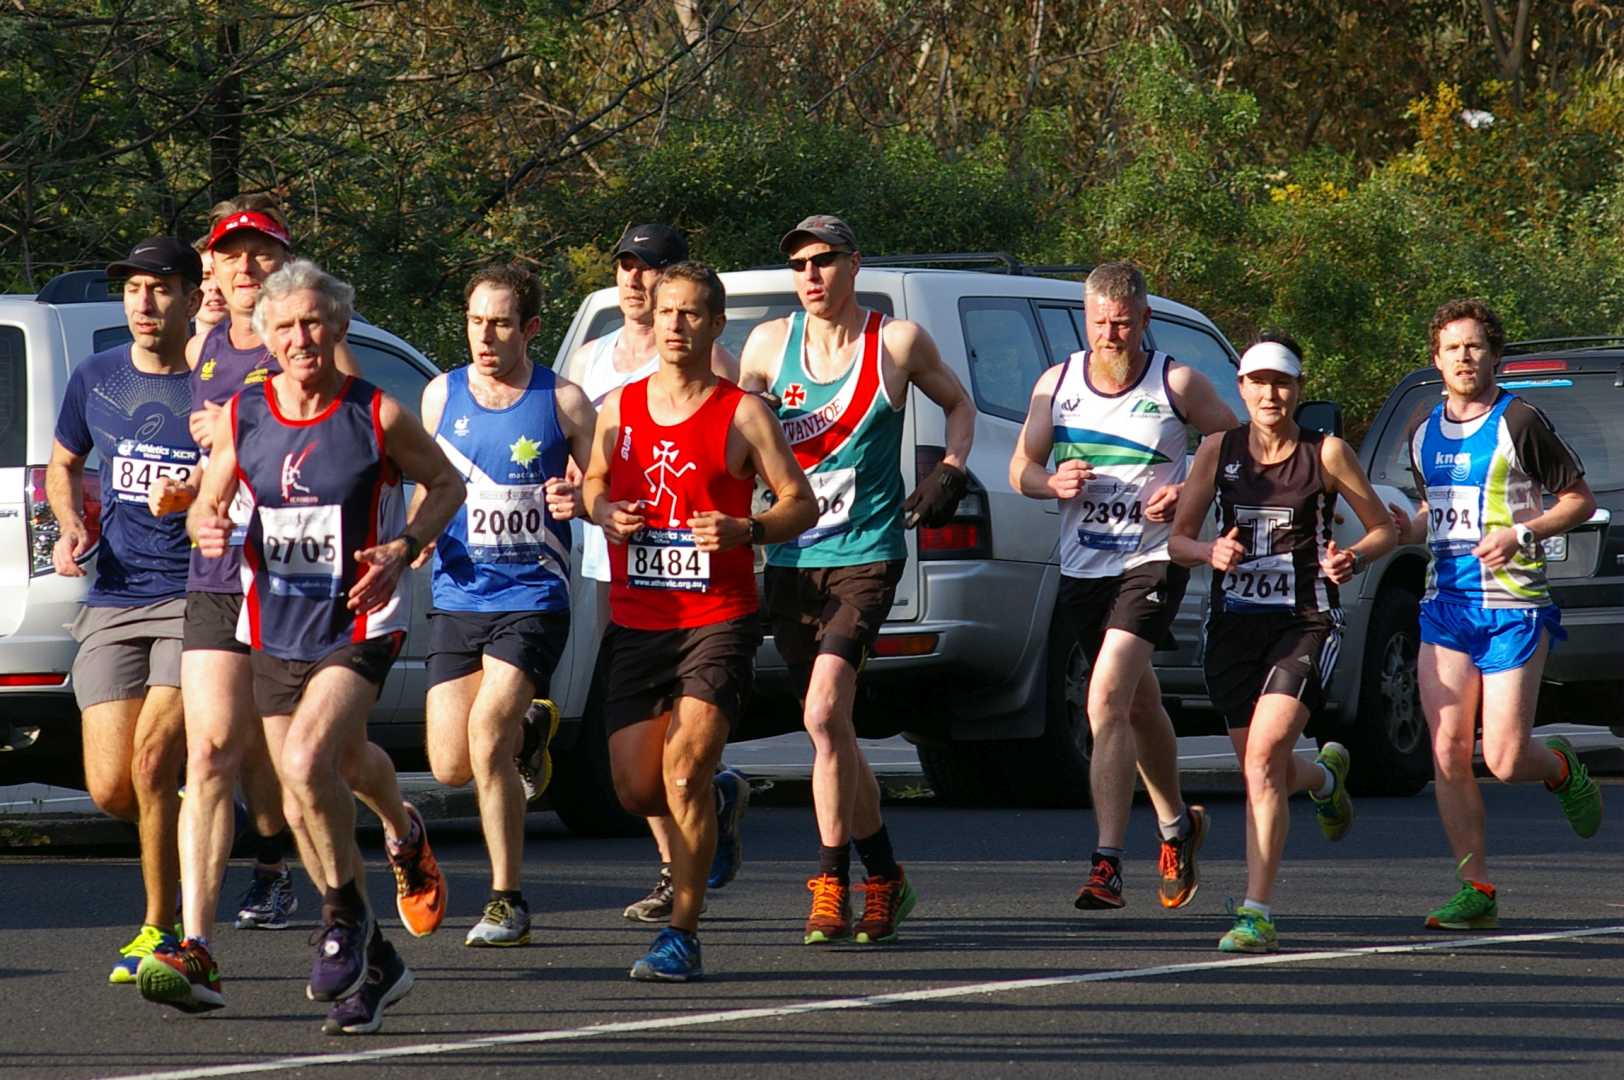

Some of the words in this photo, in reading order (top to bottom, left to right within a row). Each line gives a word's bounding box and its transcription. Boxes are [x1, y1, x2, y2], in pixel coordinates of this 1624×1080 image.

[472, 508, 540, 535] 2000
[1082, 500, 1143, 525] 2394
[266, 534, 336, 565] 2705
[634, 547, 702, 577] 8484
